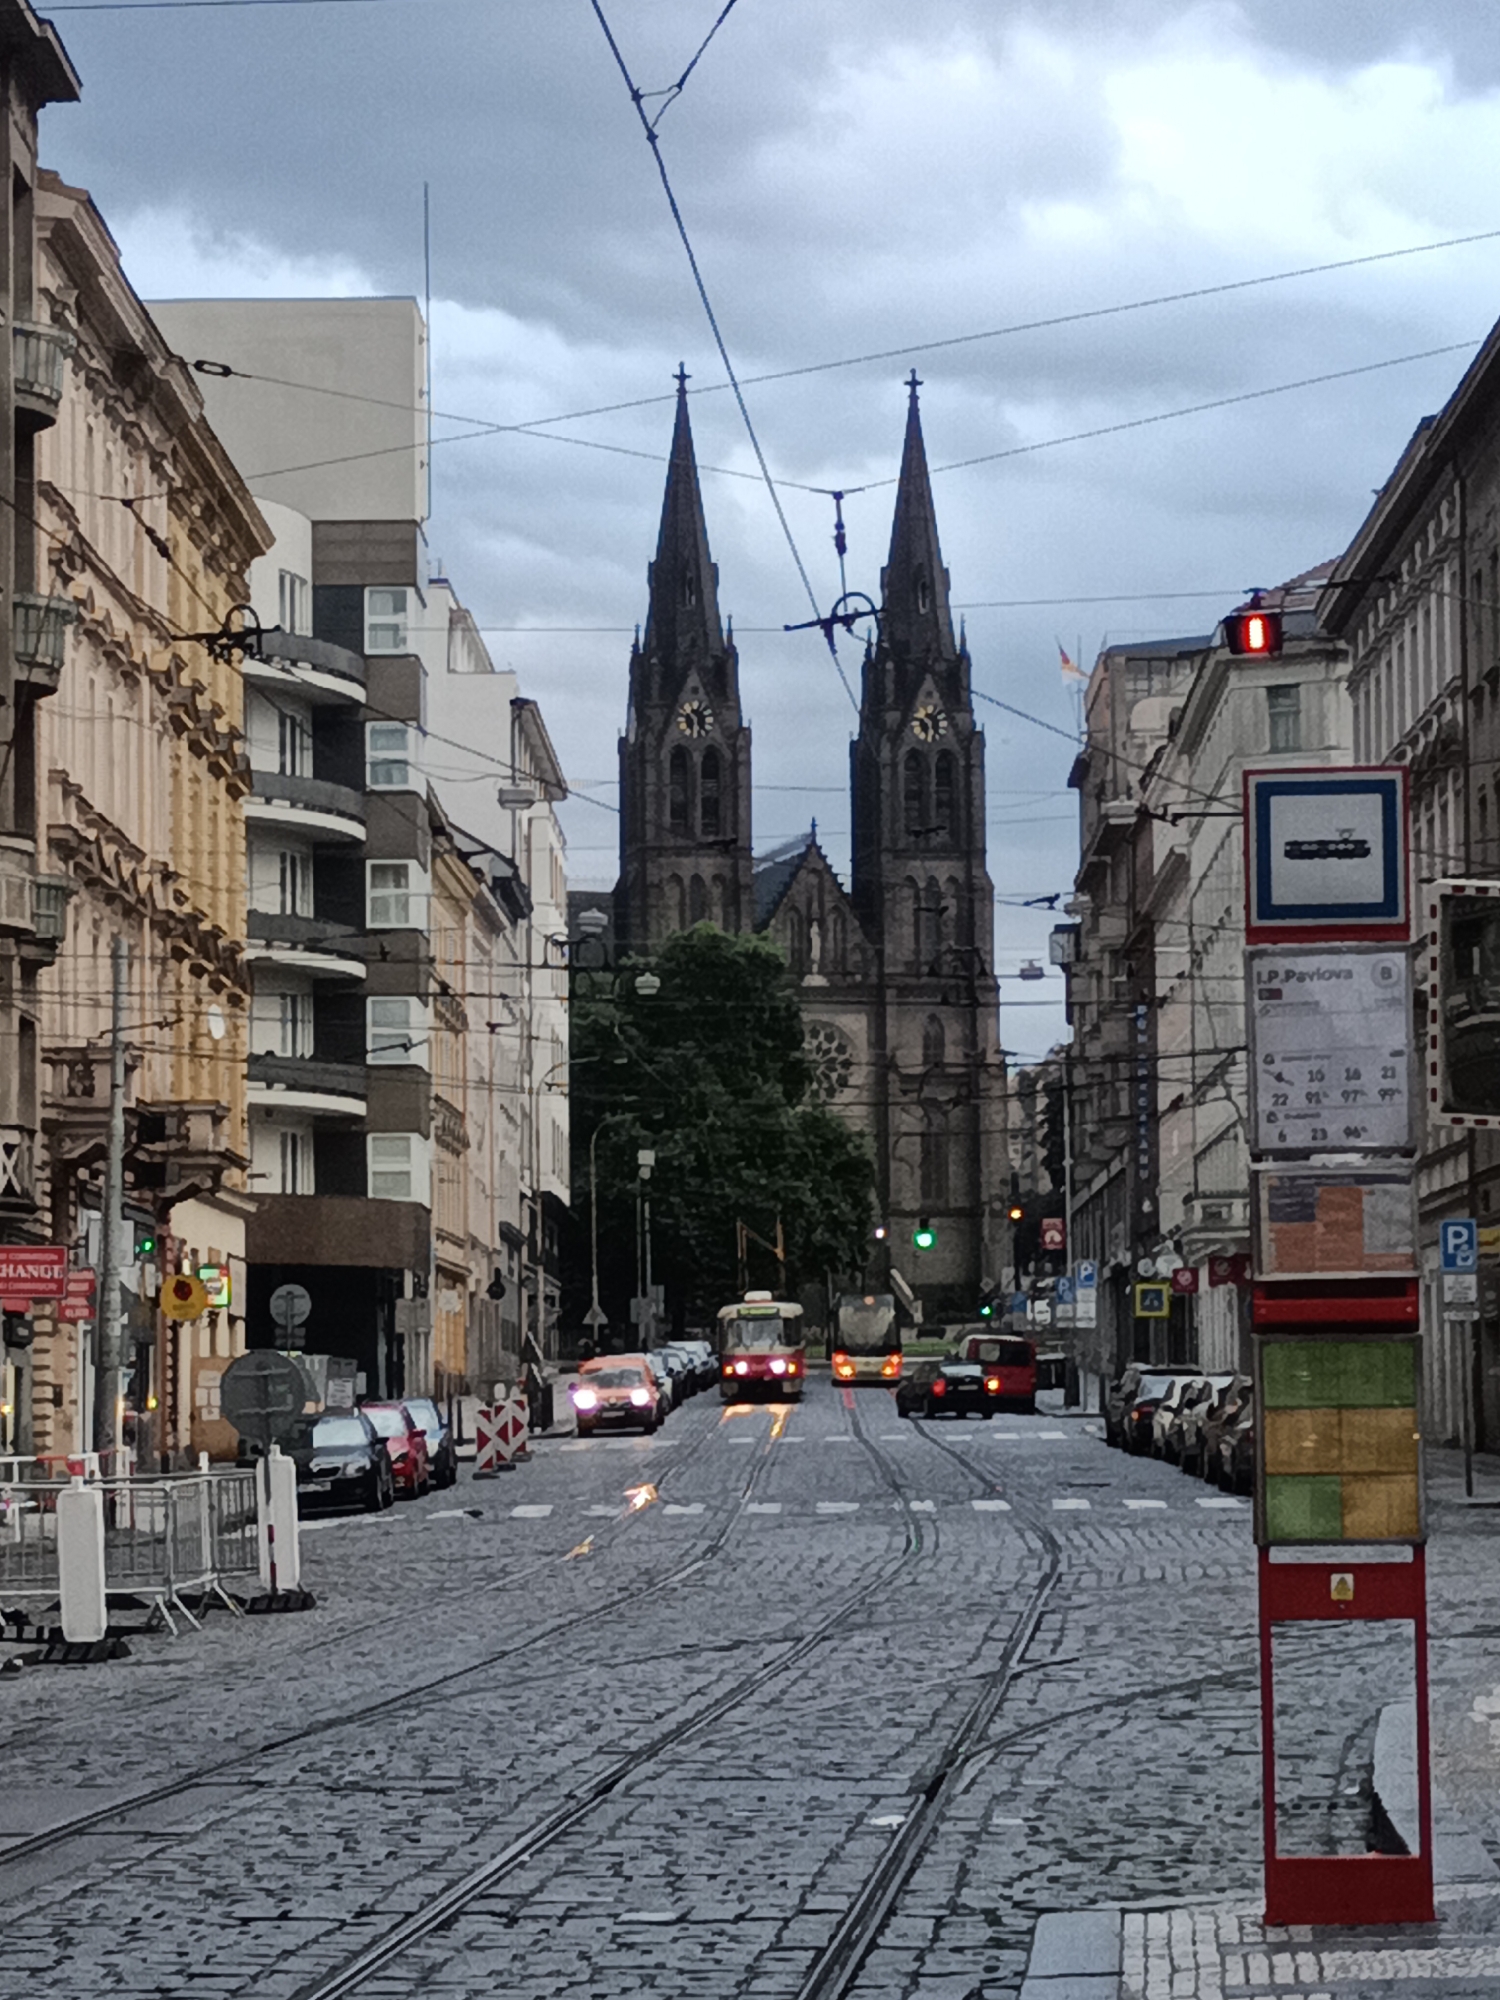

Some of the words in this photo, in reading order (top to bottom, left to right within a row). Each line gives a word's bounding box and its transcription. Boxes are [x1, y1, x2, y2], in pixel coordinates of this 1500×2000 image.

[1272, 1093, 1289, 1106] 22
[1278, 1129, 1287, 1143] 6
[1447, 1225, 1469, 1254] P
